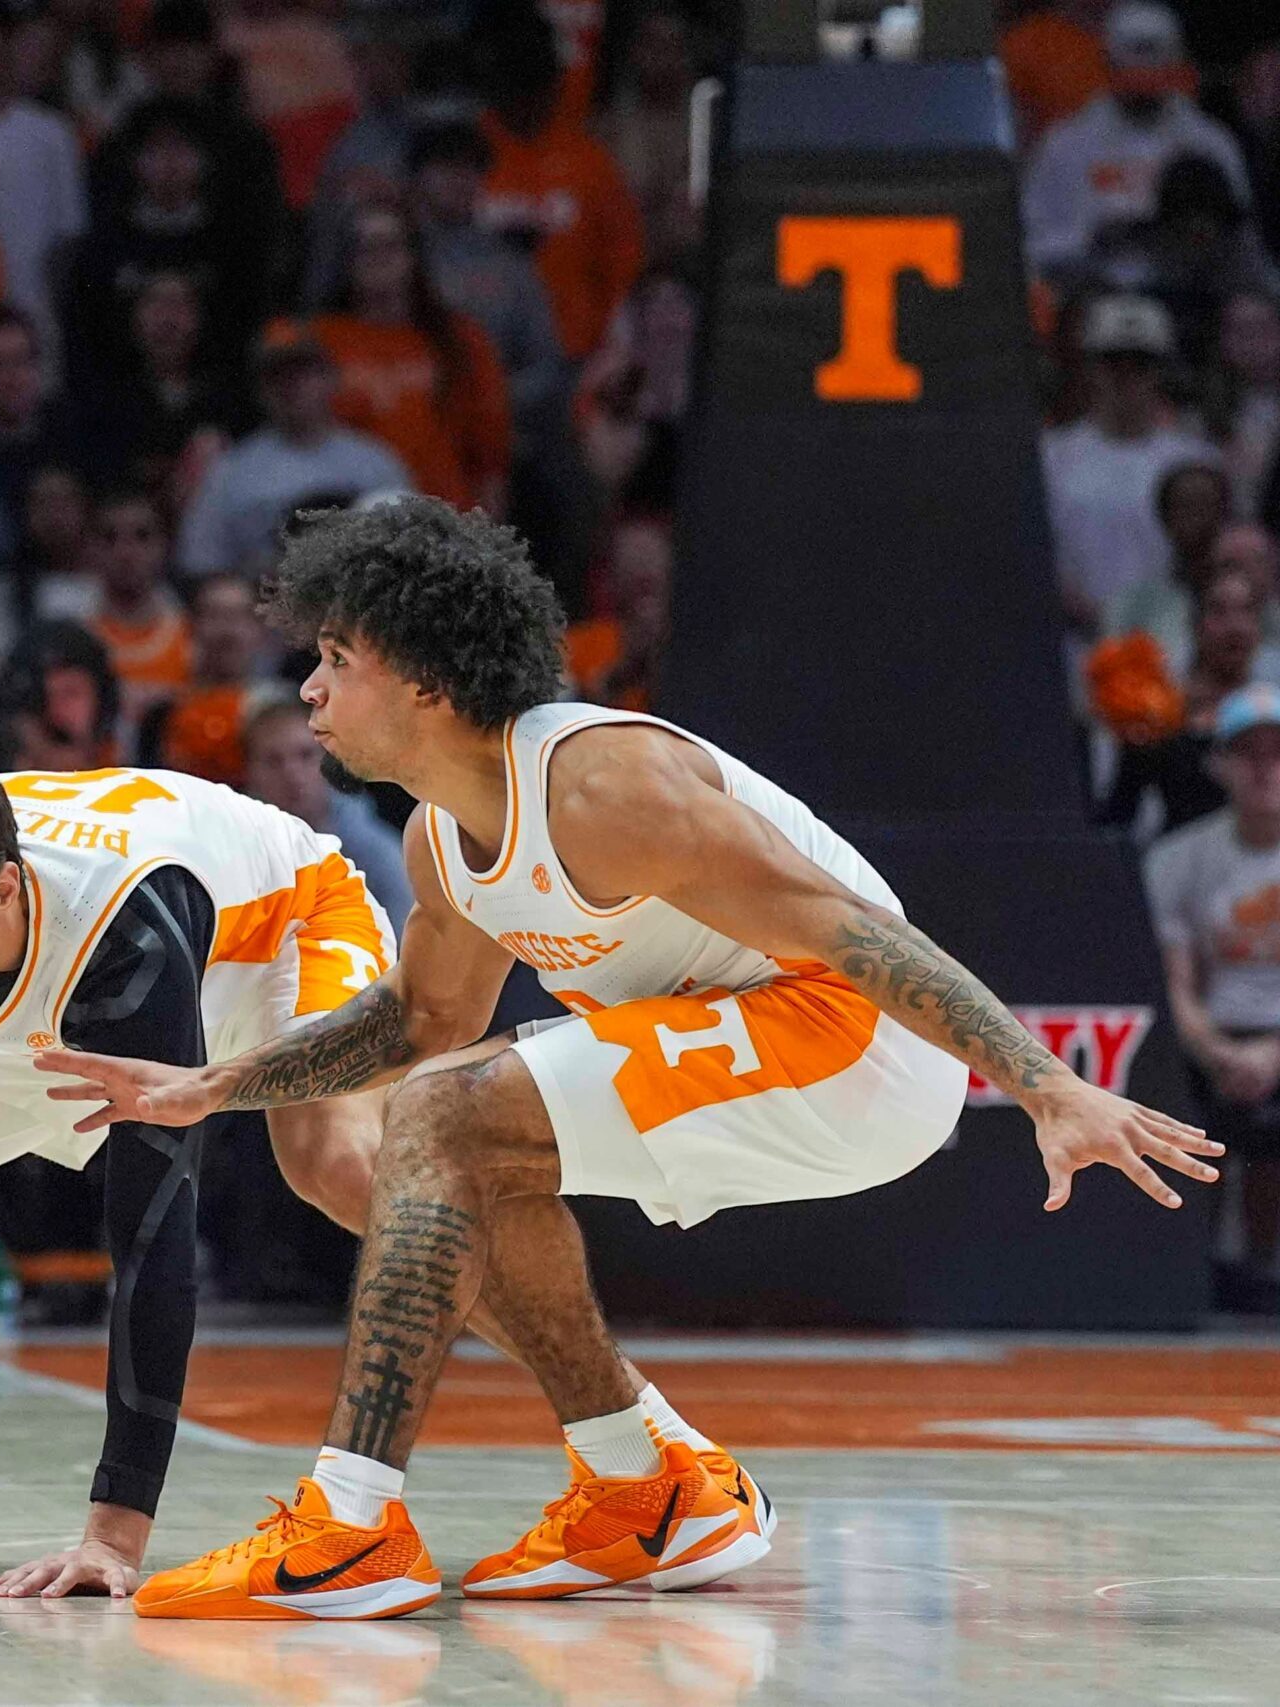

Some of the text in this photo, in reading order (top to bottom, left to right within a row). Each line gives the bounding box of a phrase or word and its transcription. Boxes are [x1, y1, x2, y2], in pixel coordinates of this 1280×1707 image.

[777, 216, 962, 399] T
[12, 806, 131, 859] PHIL
[653, 996, 762, 1077] T
